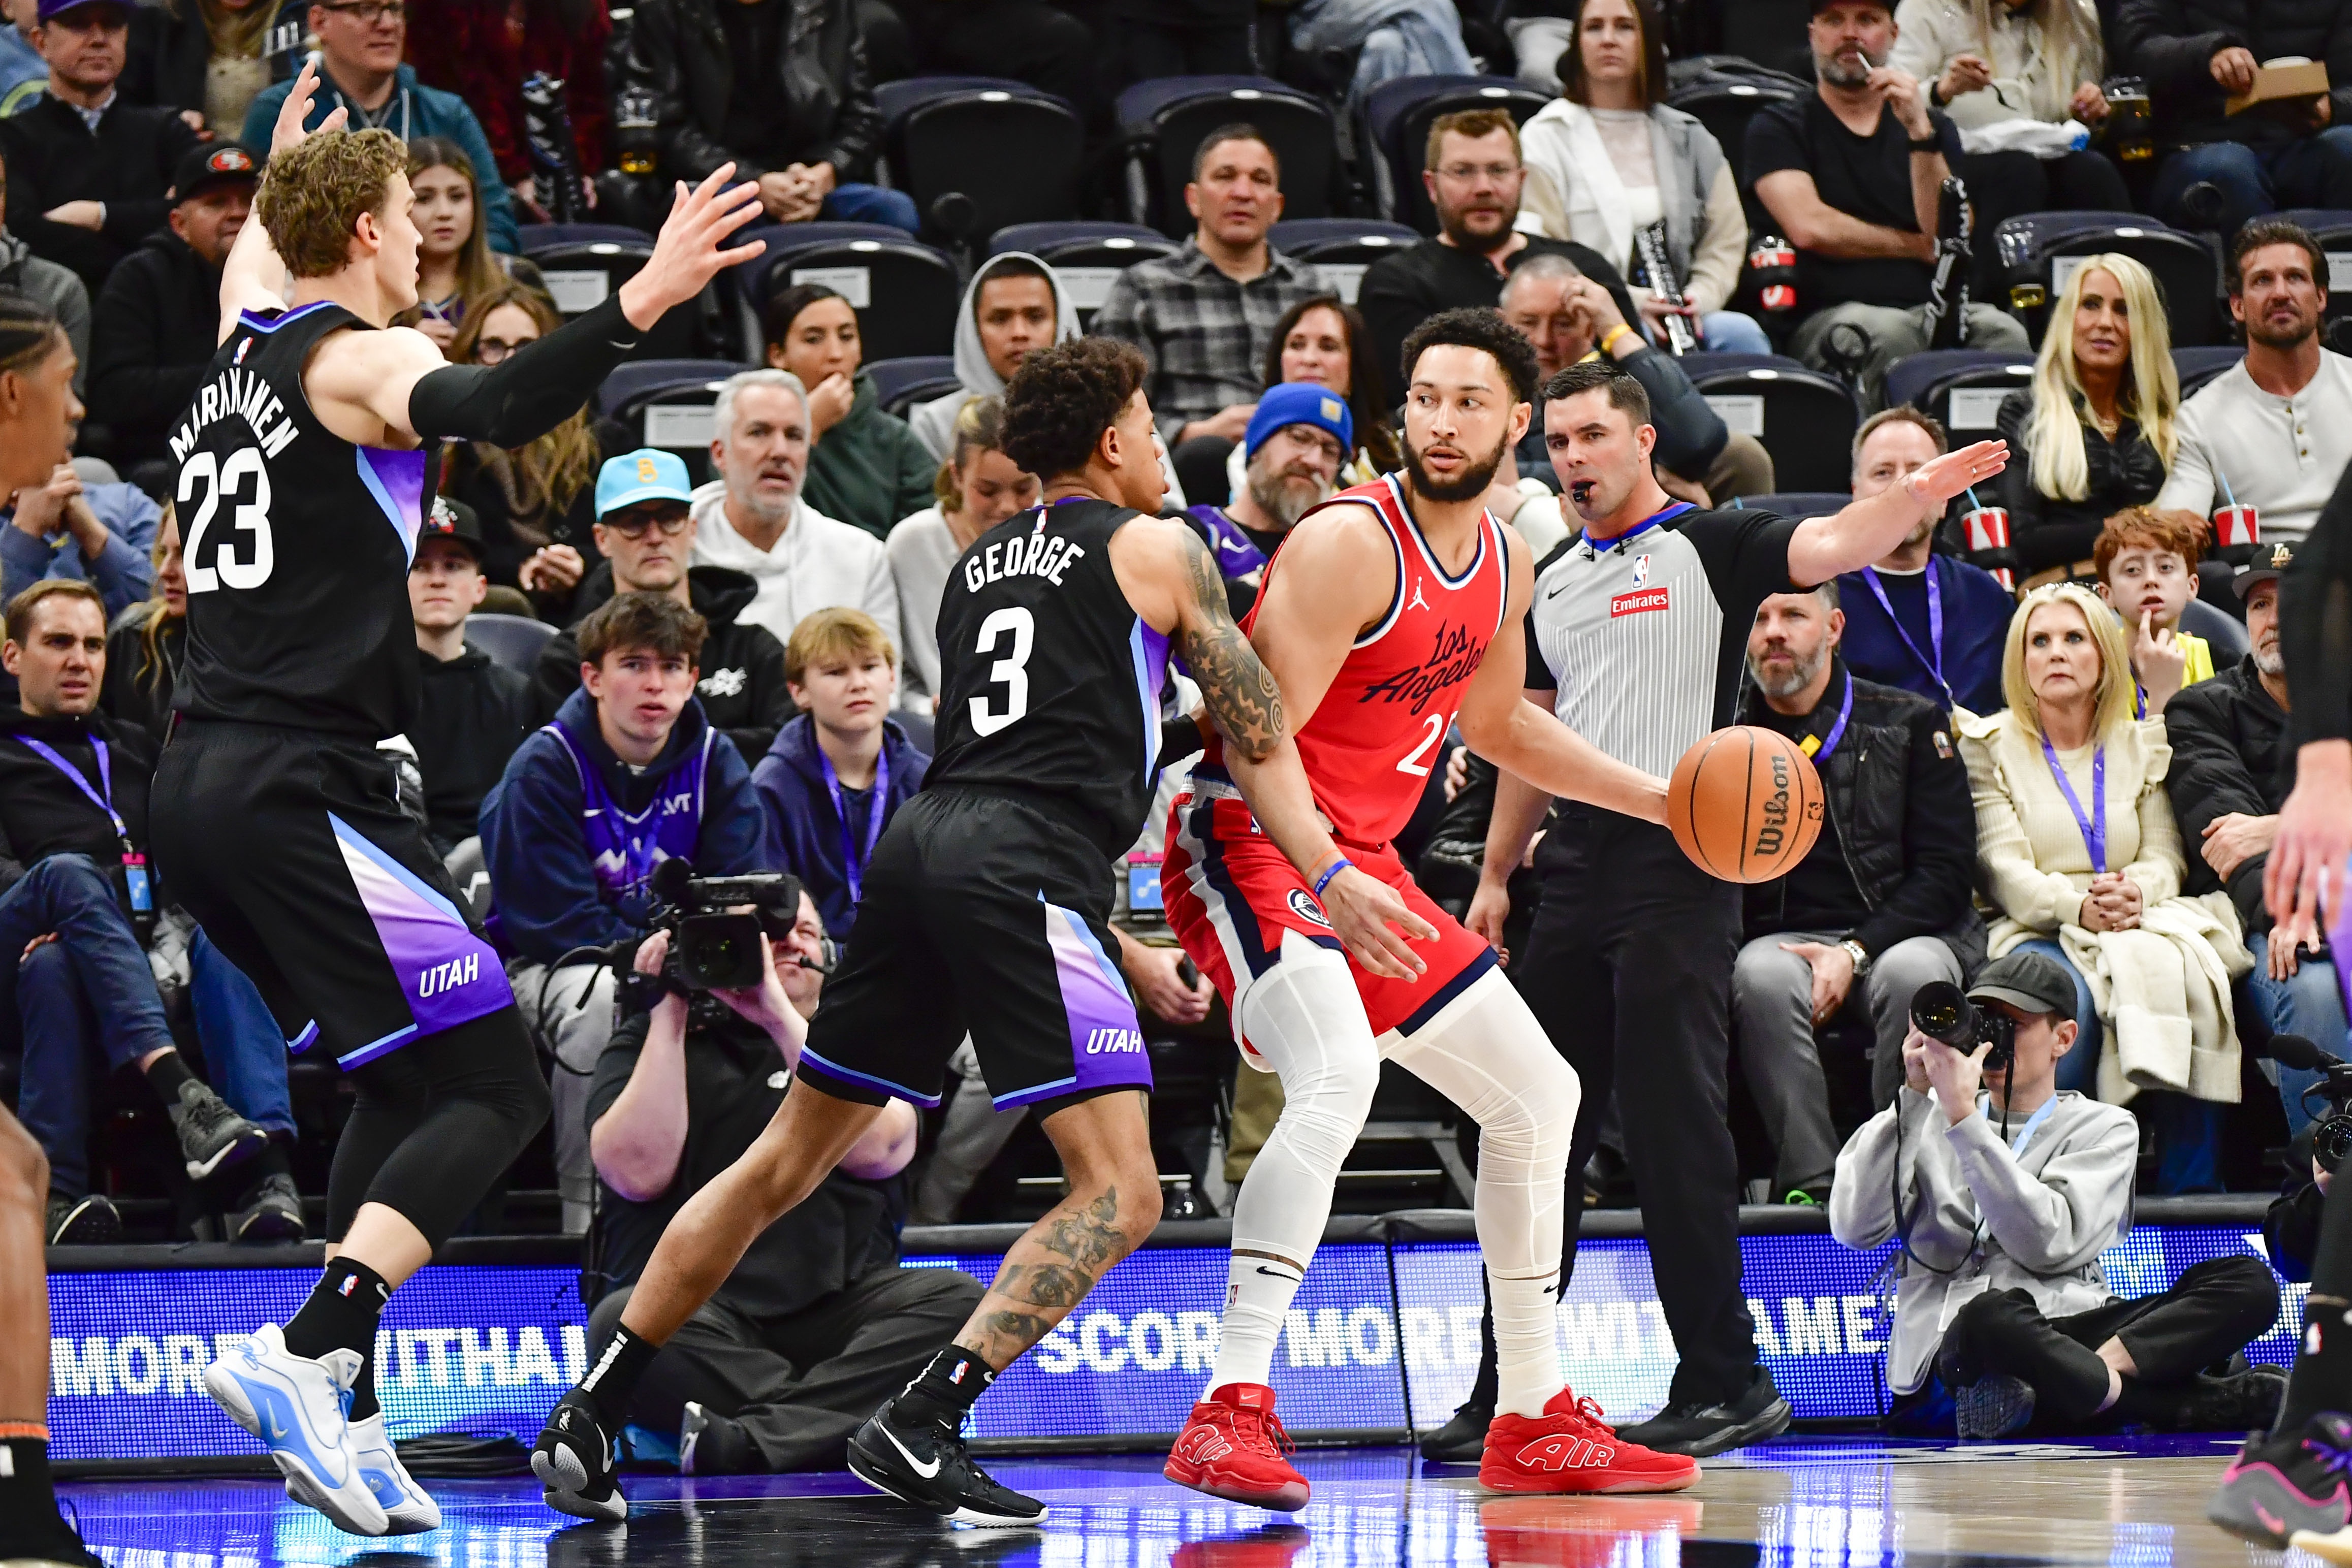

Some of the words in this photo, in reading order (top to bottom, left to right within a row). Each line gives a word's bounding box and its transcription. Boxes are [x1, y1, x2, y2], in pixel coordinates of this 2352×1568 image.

[169, 367, 300, 465] MARKKANEN
[177, 446, 274, 594] 23
[965, 533, 1086, 593] GEORGE
[1612, 594, 1667, 613] Emirates
[968, 606, 1035, 738] 3
[1424, 618, 1468, 669] Los
[1396, 710, 1458, 777] 2
[1754, 755, 1789, 856] Wilson
[419, 952, 479, 998] UTAH
[1086, 1028, 1142, 1054] UTAH
[51, 1333, 252, 1396] MOR
[1037, 1309, 1224, 1372] SCOR
[1285, 1305, 1484, 1367] MORE
[1178, 1423, 1233, 1465] AIR
[1515, 1433, 1615, 1471] AIR
